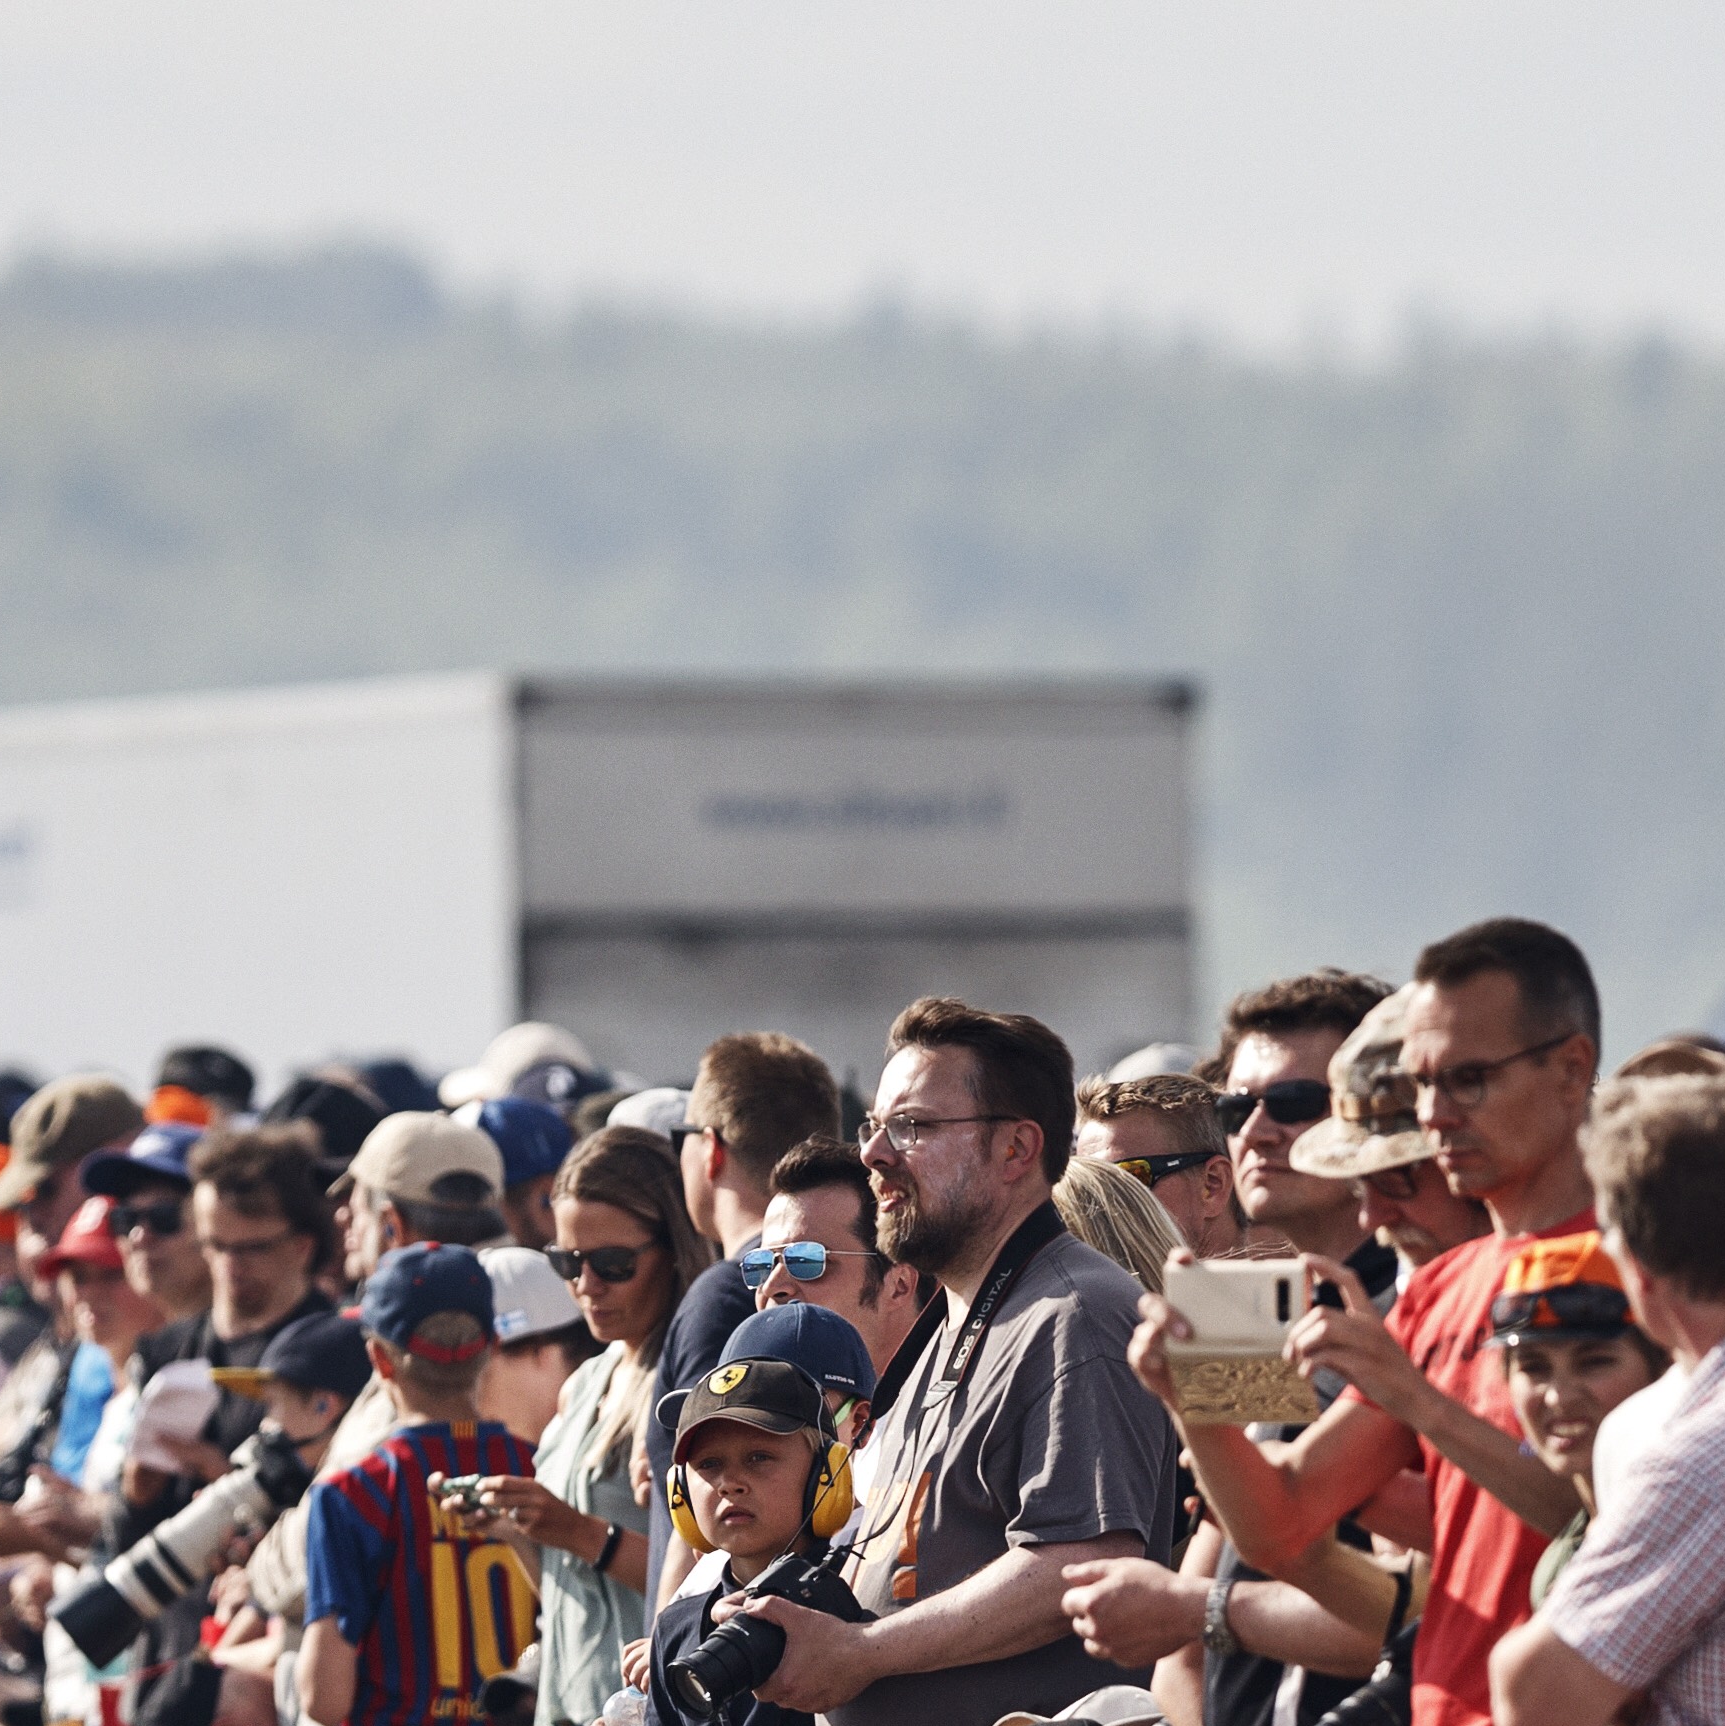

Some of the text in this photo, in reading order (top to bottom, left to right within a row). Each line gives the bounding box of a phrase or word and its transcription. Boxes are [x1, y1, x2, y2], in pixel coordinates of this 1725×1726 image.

[952, 1267, 1013, 1370] EOS DIGITAL
[430, 1542, 537, 1688] 10
[430, 1694, 485, 1721] unic
